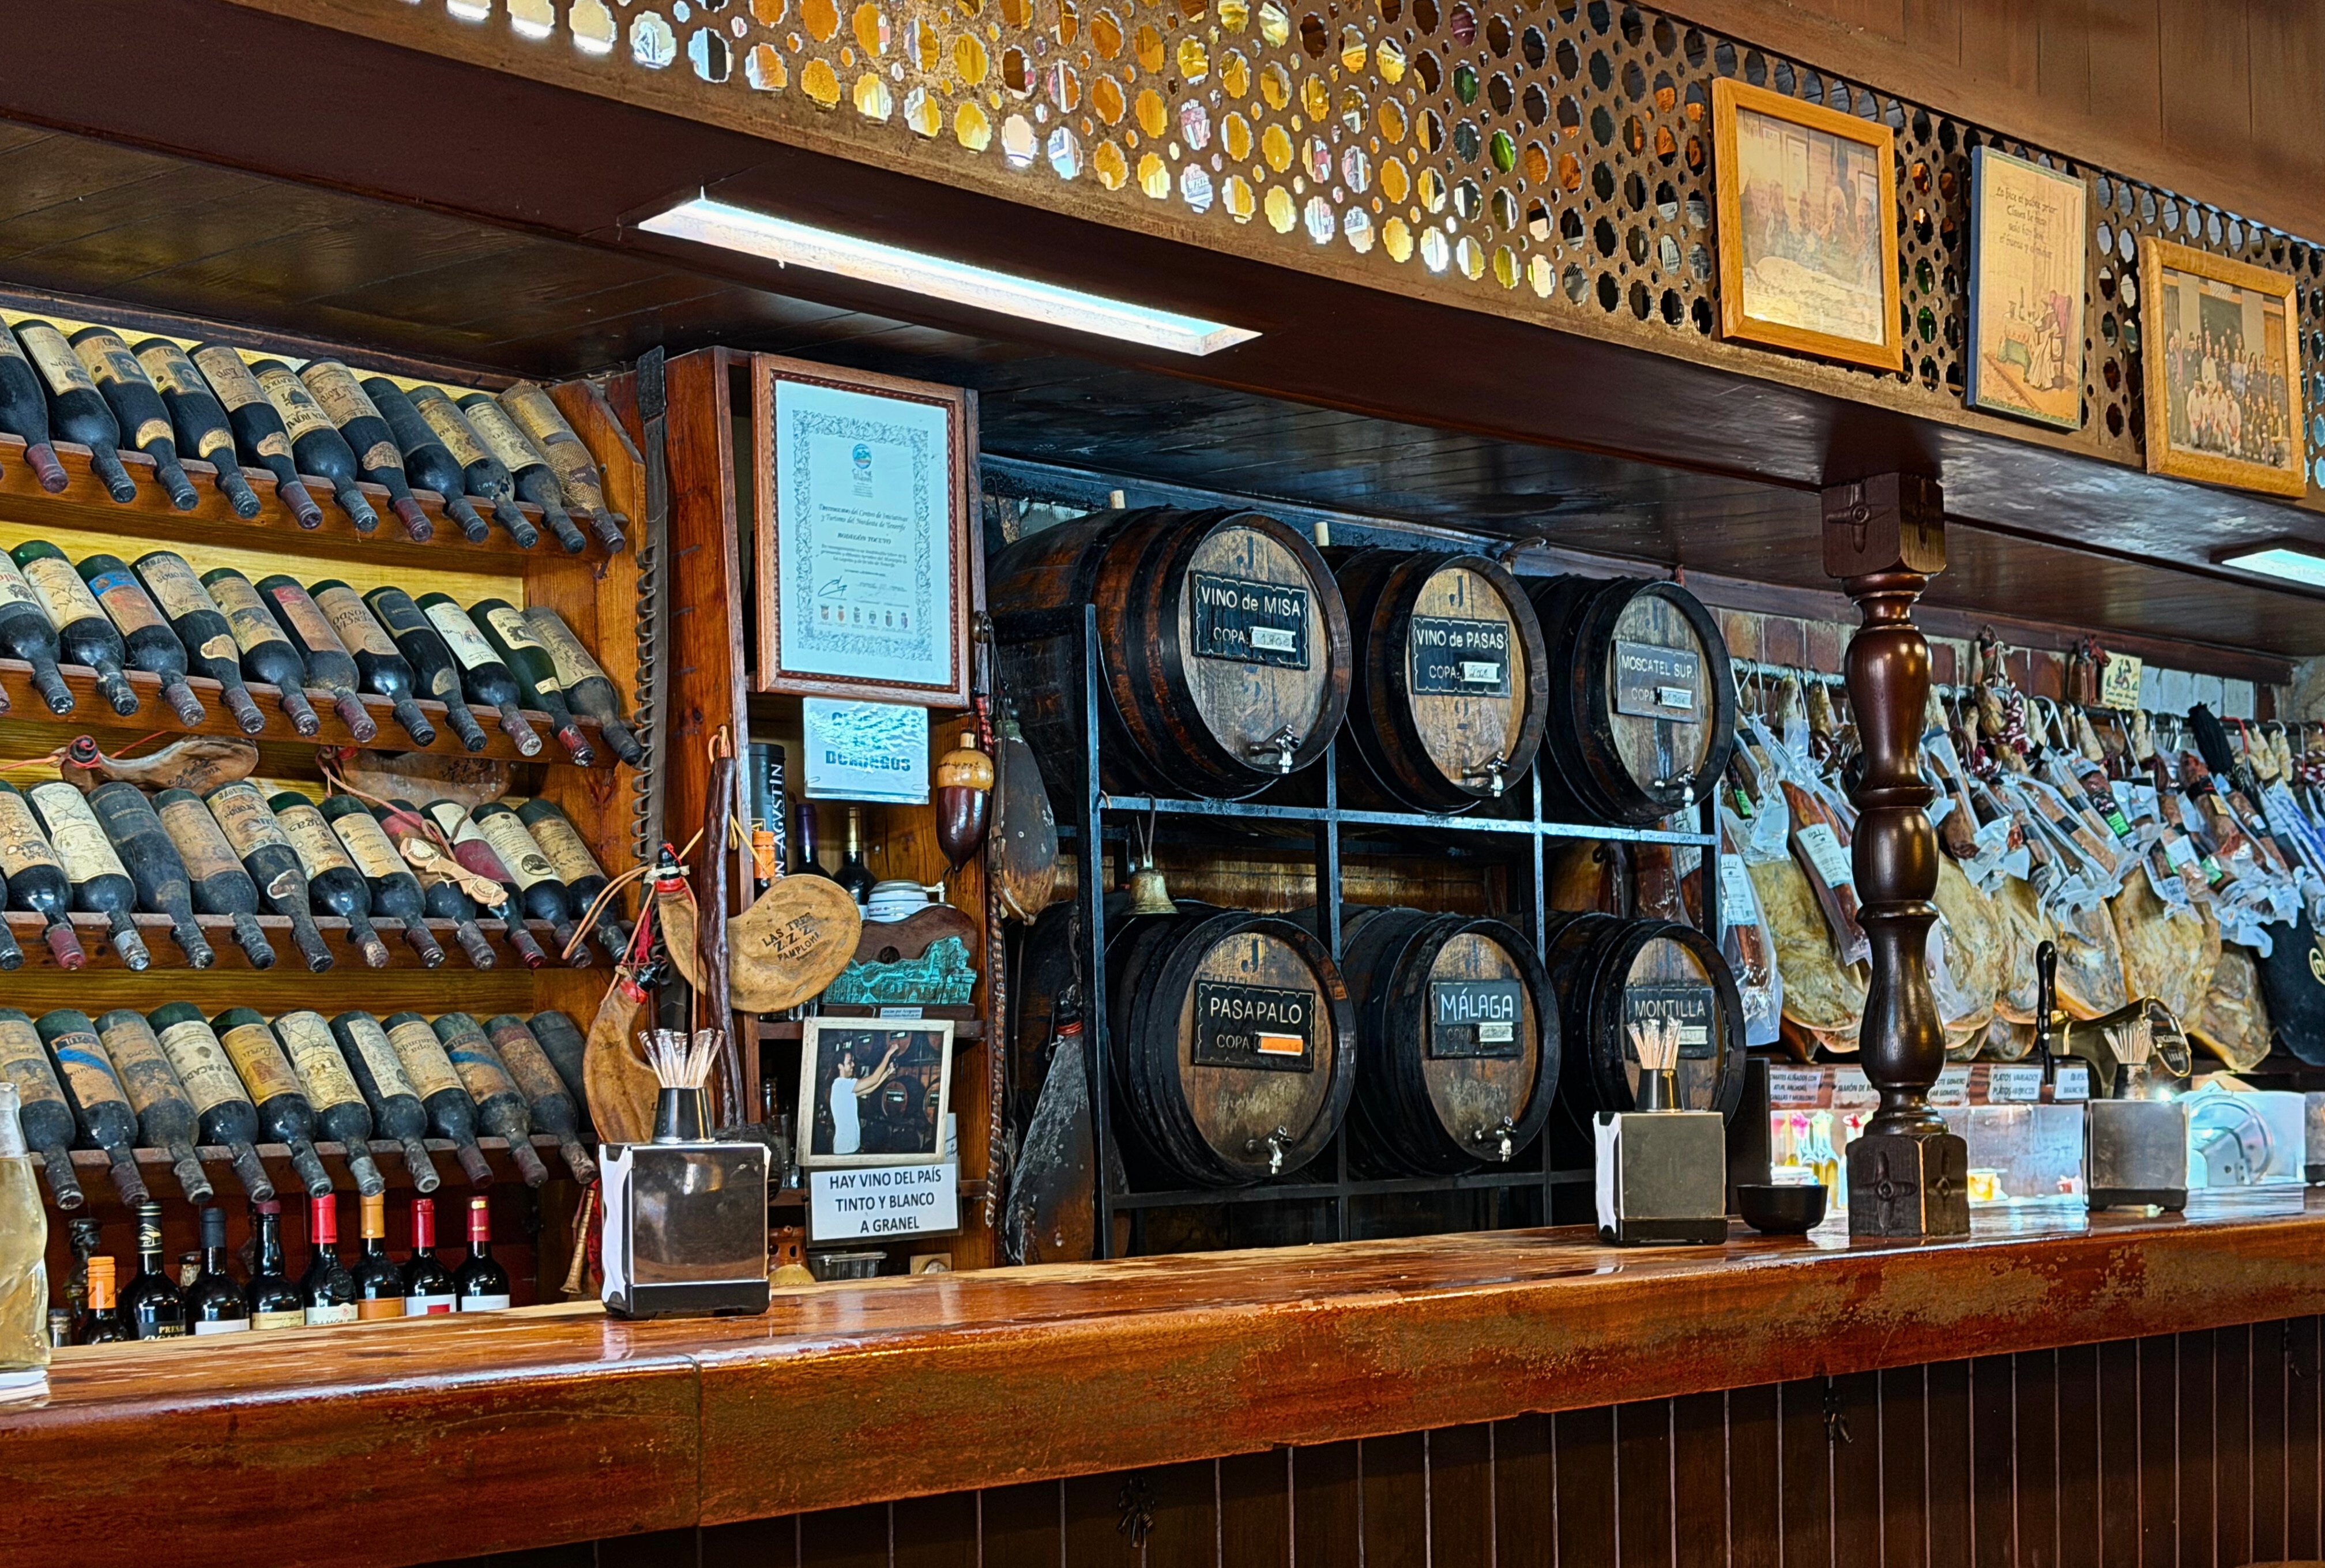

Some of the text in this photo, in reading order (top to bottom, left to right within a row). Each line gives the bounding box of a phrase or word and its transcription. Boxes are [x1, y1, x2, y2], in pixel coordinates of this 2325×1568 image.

[1201, 586, 1300, 616] VINO de MISA
[1416, 629, 1504, 649] VINO de PASAS
[1621, 655, 1695, 679] MOSCATEL SUP.
[761, 912, 812, 947] LAS TRES
[1210, 997, 1302, 1024] PASAPALO
[1441, 987, 1513, 1022] MÁLAGA
[1635, 999, 1706, 1017] MONTILLA
[1217, 1035, 1250, 1050] COPA
[1993, 1073, 2011, 1082] PLATOS
[830, 1165, 942, 1190] HAY VINO DEL PAÍS
[835, 1191, 935, 1212] TINTO Y BLANCO
[860, 1216, 920, 1234] A GRANEL
